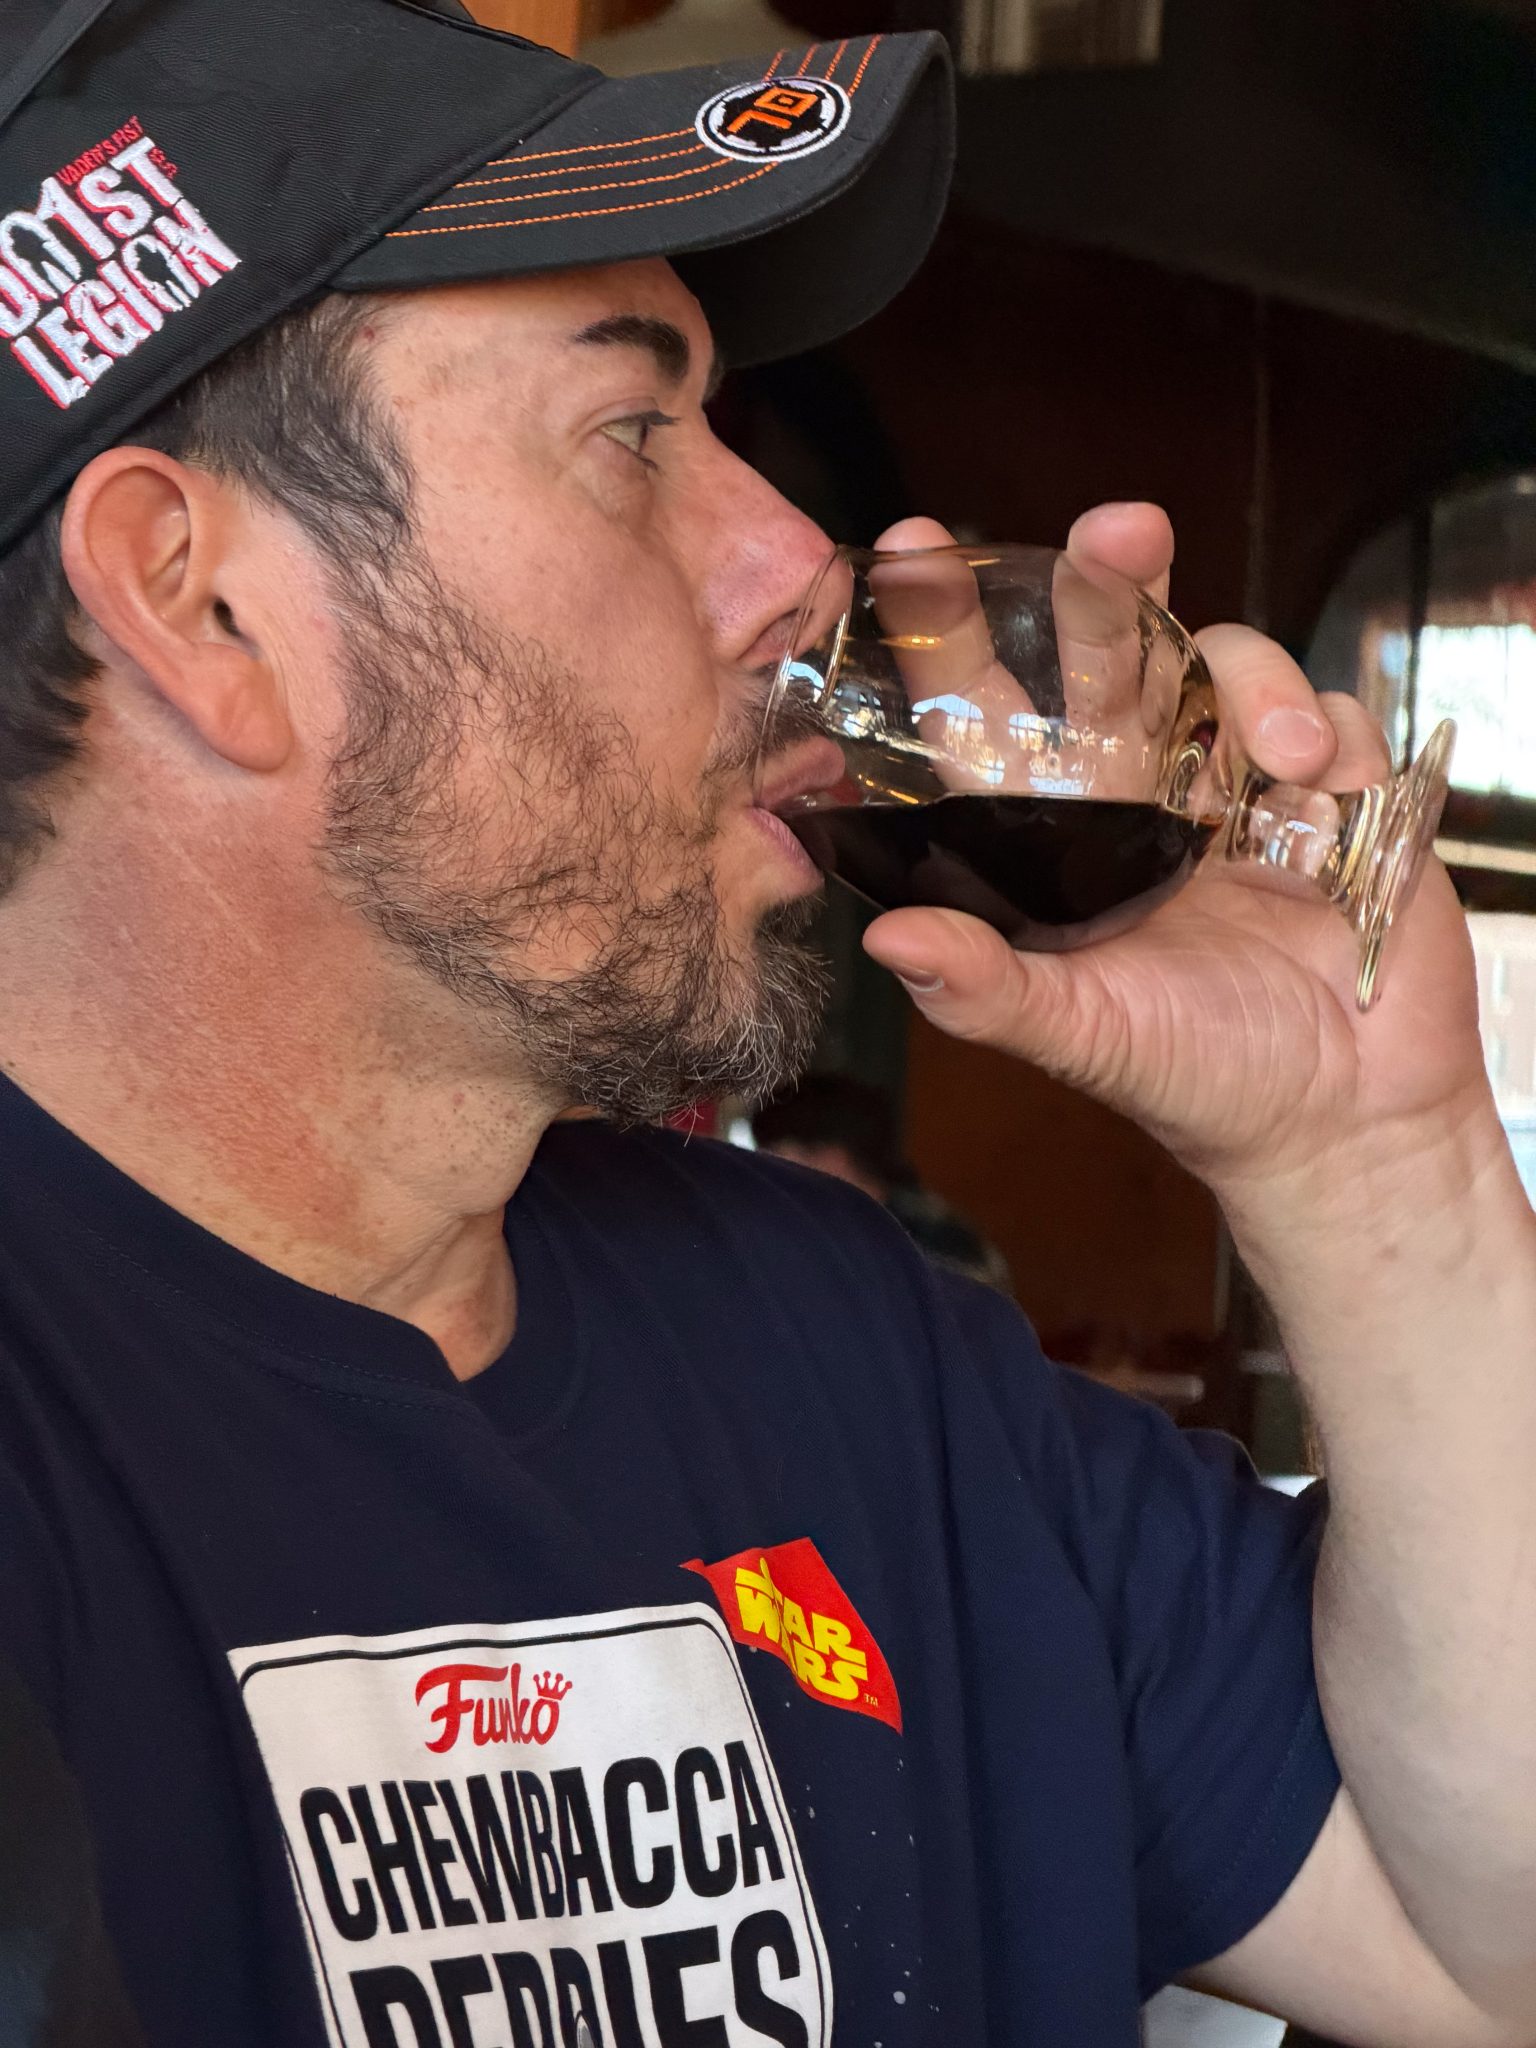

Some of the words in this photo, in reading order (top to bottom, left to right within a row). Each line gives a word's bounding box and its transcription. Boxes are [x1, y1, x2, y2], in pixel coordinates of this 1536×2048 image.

[111, 115, 144, 149] FIST
[10, 200, 242, 409] LEGION
[735, 1557, 867, 1668] SAR
[415, 1663, 560, 1753] Funko
[300, 1741, 786, 1942] CHEWBACCA
